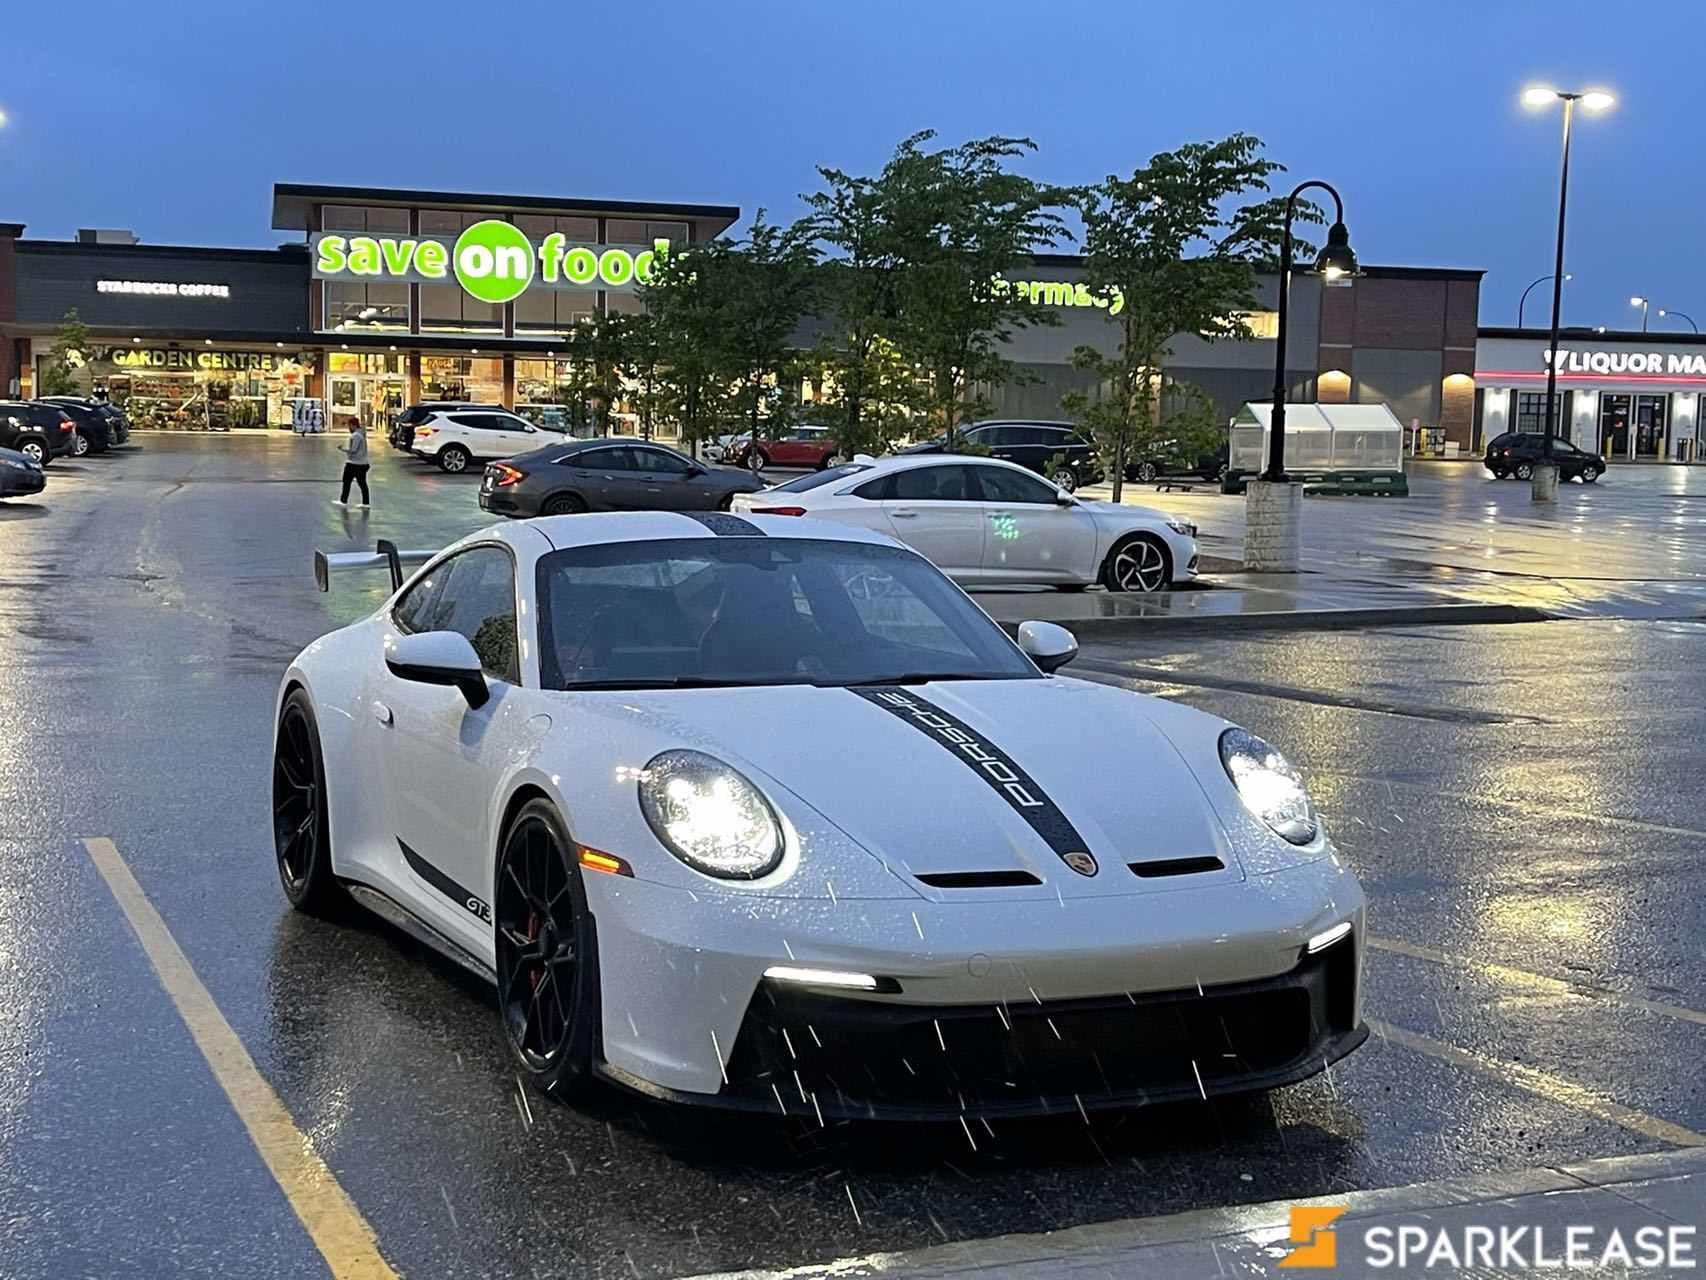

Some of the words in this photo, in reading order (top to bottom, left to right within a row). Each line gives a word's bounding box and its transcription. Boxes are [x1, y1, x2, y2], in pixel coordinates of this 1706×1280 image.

[317, 235, 449, 278] save
[459, 243, 528, 280] on
[539, 232, 697, 286] food
[112, 350, 193, 367] GARDEN
[197, 352, 272, 370] CENTRE
[1569, 351, 1663, 374] LIQUOR
[876, 692, 1044, 807] PORSCHE
